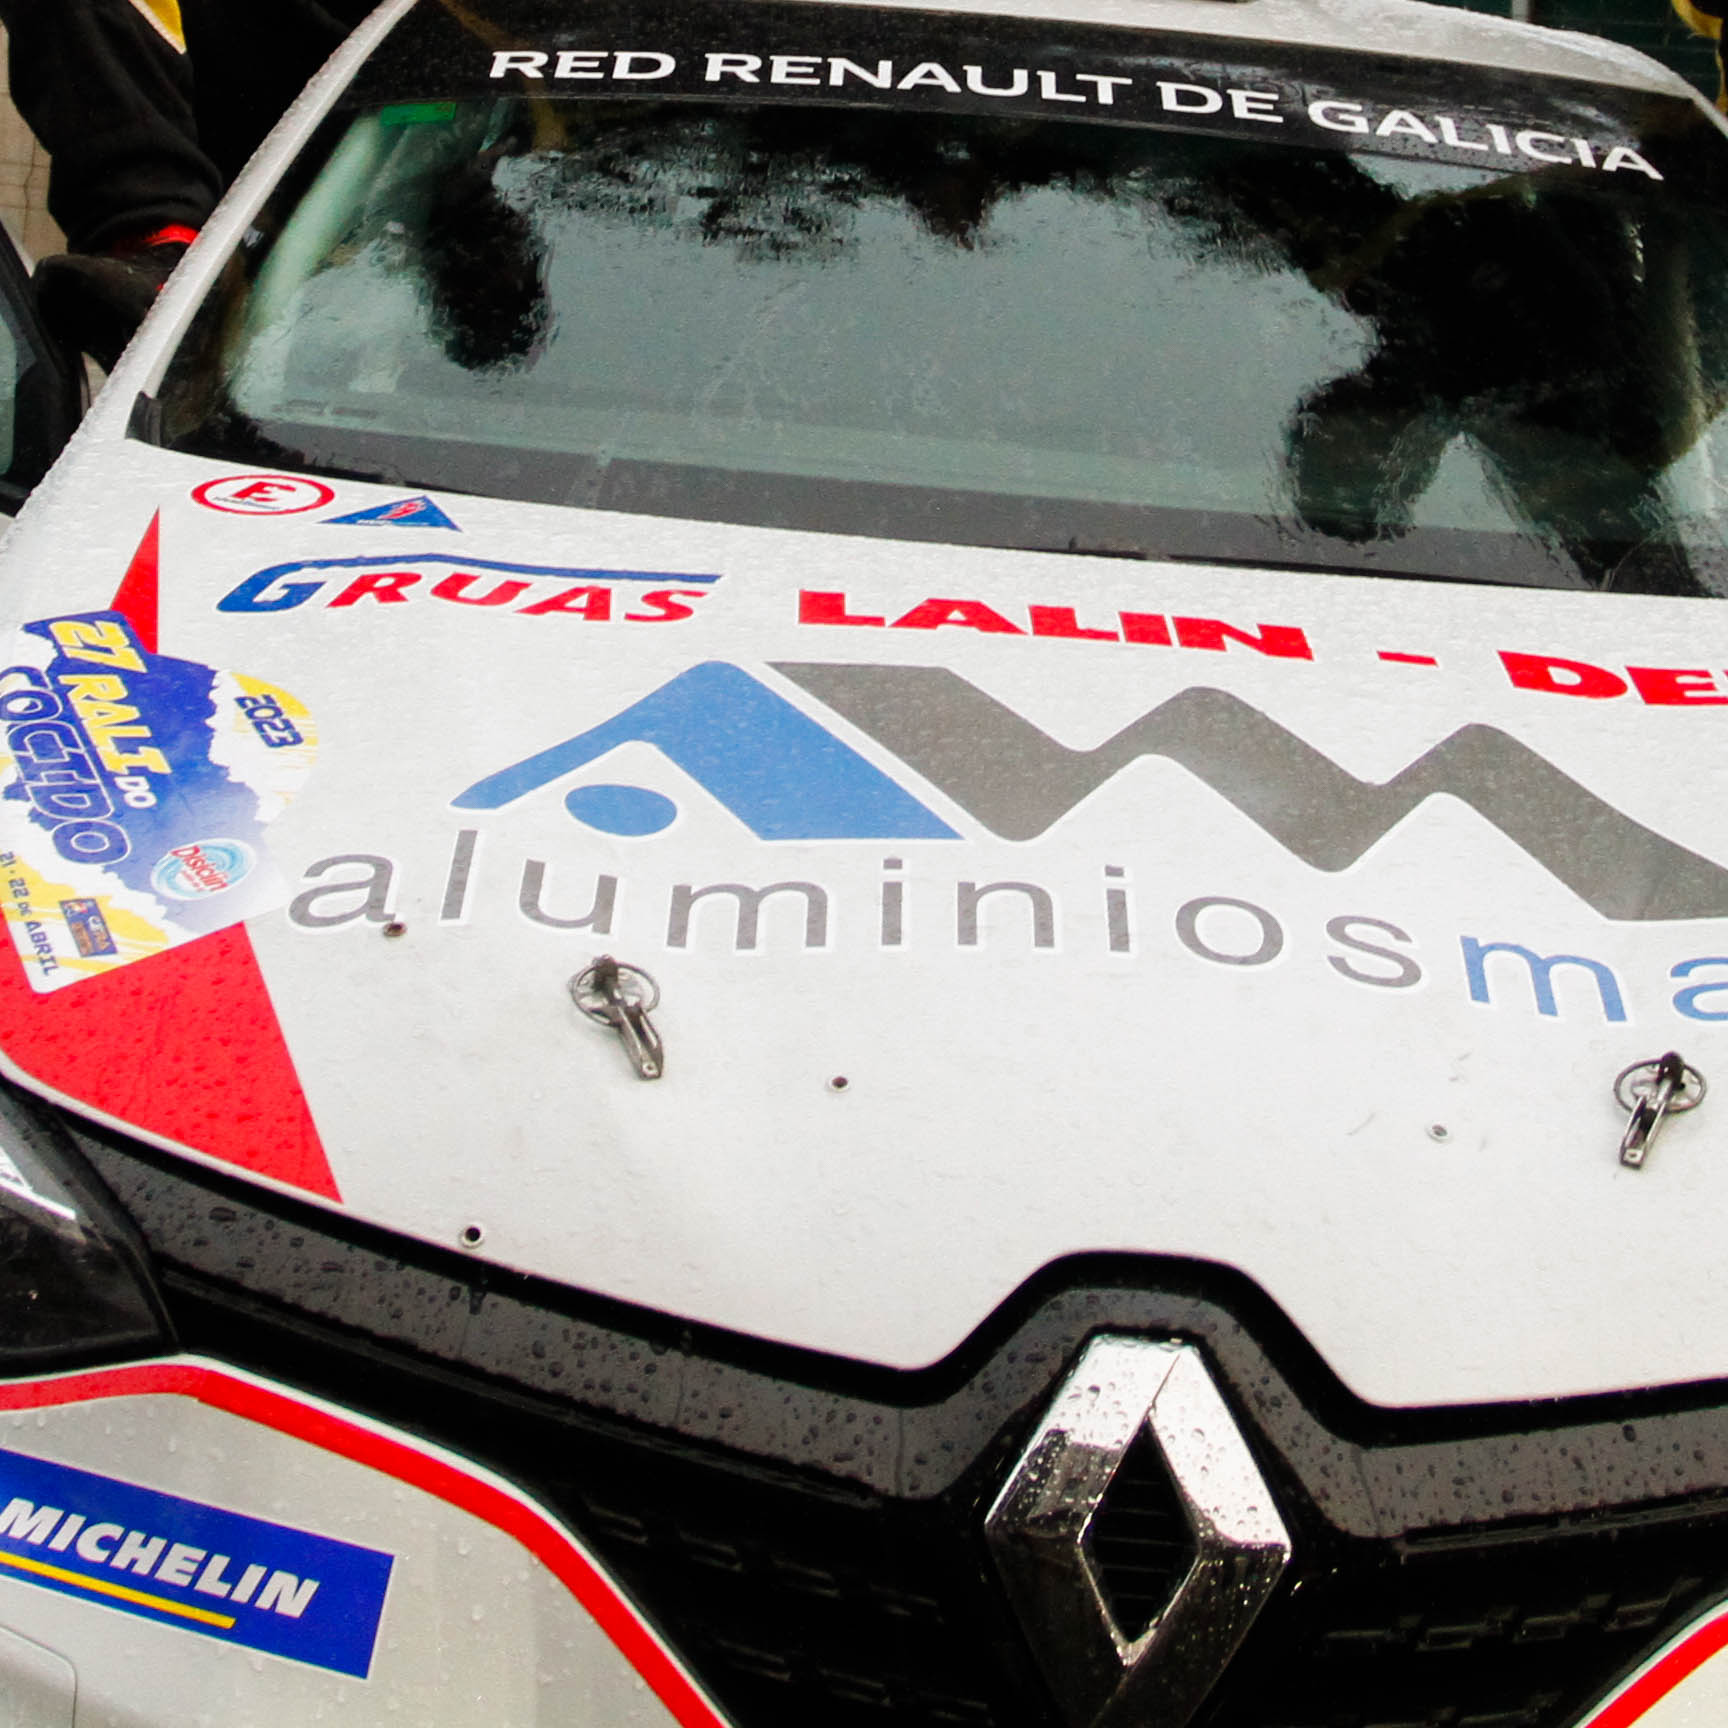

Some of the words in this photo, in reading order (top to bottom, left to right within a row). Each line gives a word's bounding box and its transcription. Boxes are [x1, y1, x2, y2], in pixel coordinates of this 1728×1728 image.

[489, 50, 676, 79] RED
[704, 52, 1132, 105] RENAULT
[1155, 80, 1285, 124] DE
[1306, 99, 1665, 182] GALICIA
[49, 619, 148, 674] 27
[216, 554, 722, 623] GRUAS
[798, 589, 1313, 661] LALIN
[58, 673, 173, 776] RALI
[234, 693, 304, 749] 2023
[114, 775, 158, 810] DO
[0, 851, 17, 868] 21
[9, 877, 30, 898] 22
[25, 920, 60, 976] ABRIL
